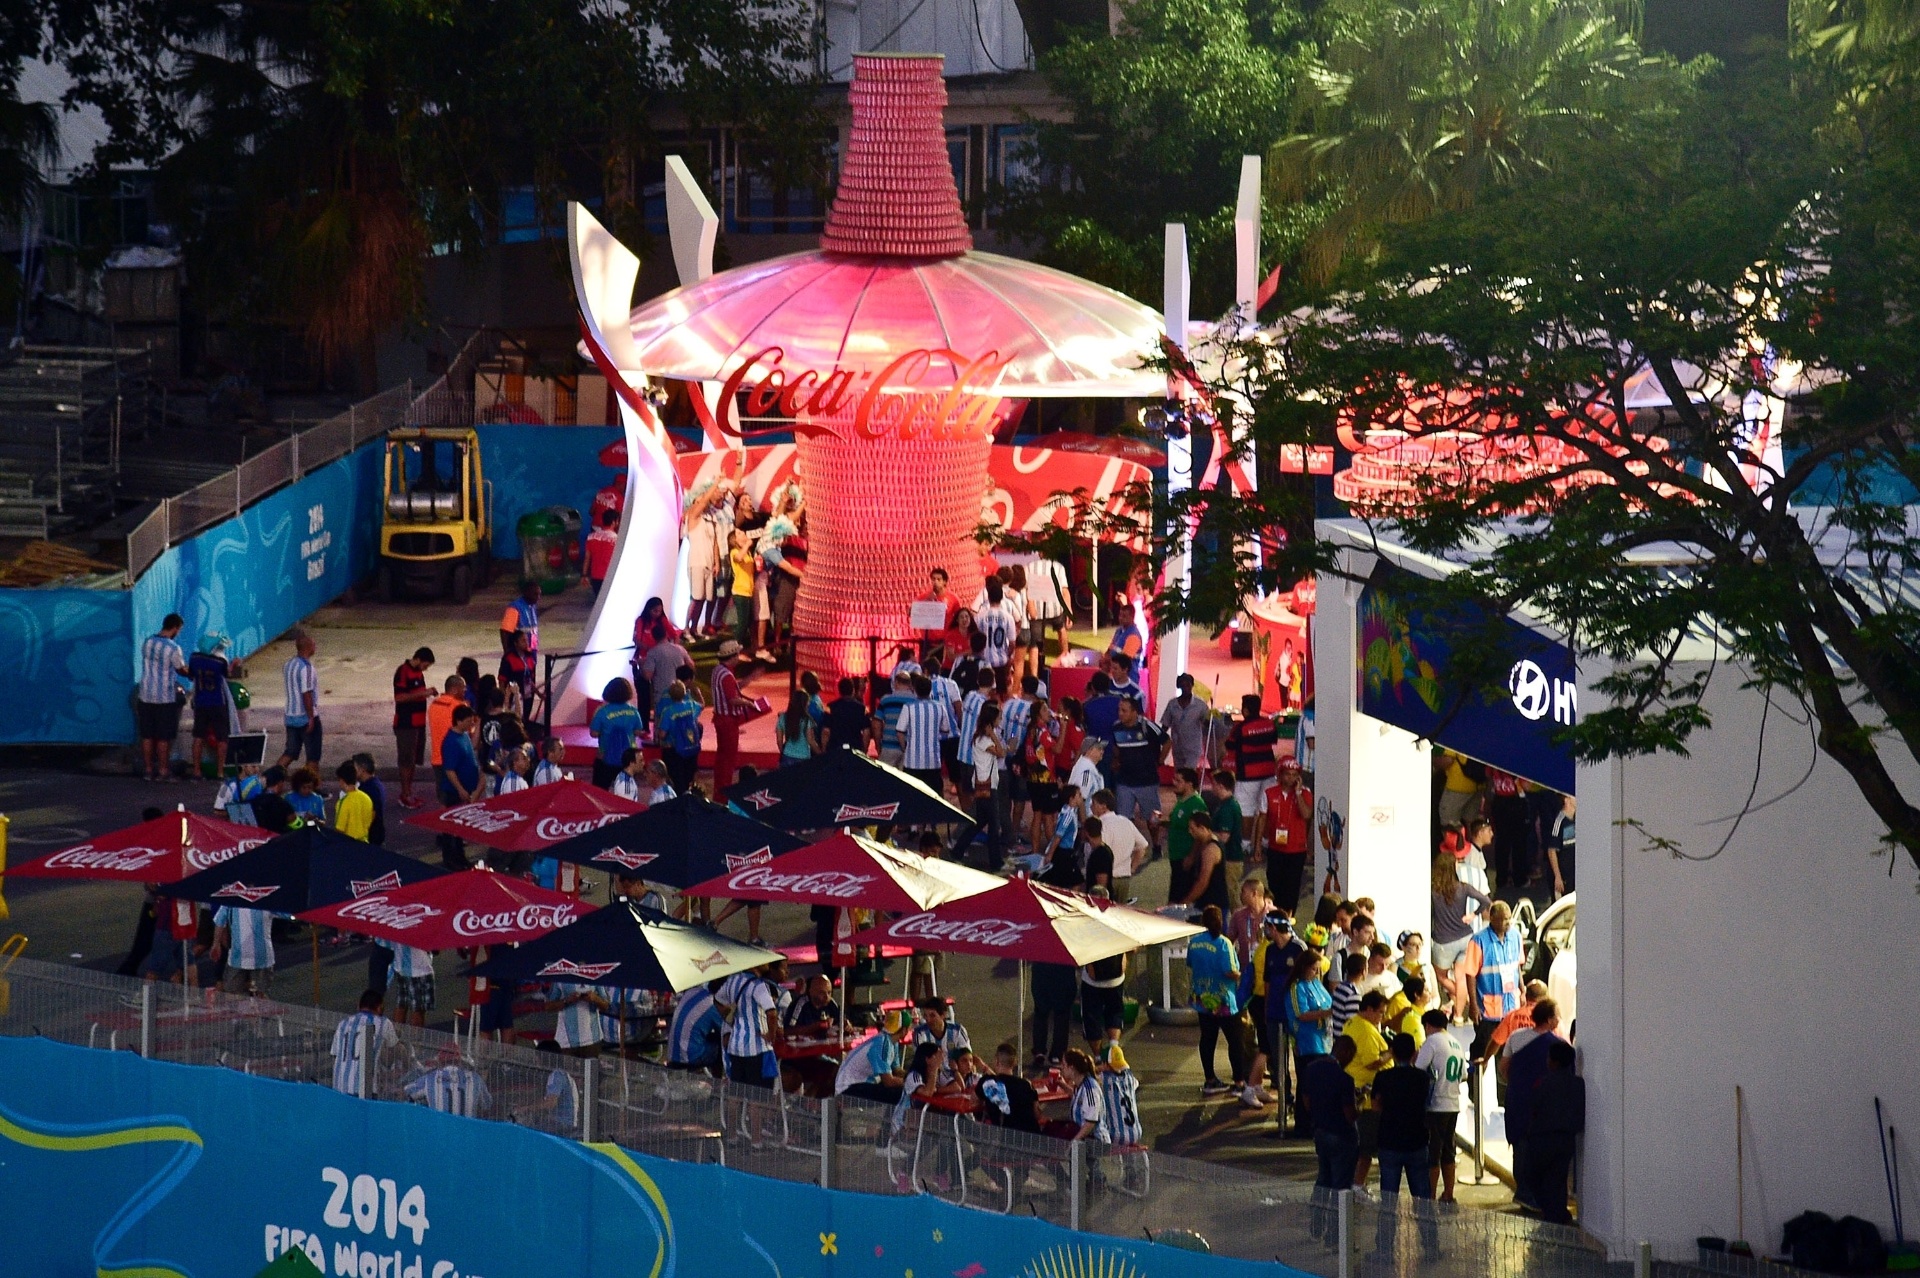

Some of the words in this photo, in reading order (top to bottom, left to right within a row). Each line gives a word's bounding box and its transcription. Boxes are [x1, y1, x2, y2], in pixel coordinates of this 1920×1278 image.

[716, 346, 1018, 442] Coca-Cola
[988, 626, 1005, 649] 10
[45, 845, 168, 871] Coca-Cola
[728, 867, 876, 897] Coca-Cola
[337, 896, 444, 929] Coca-Cola
[888, 912, 1038, 946] Coca-Cola
[322, 1167, 430, 1246] 2014
[334, 1240, 423, 1278] World
